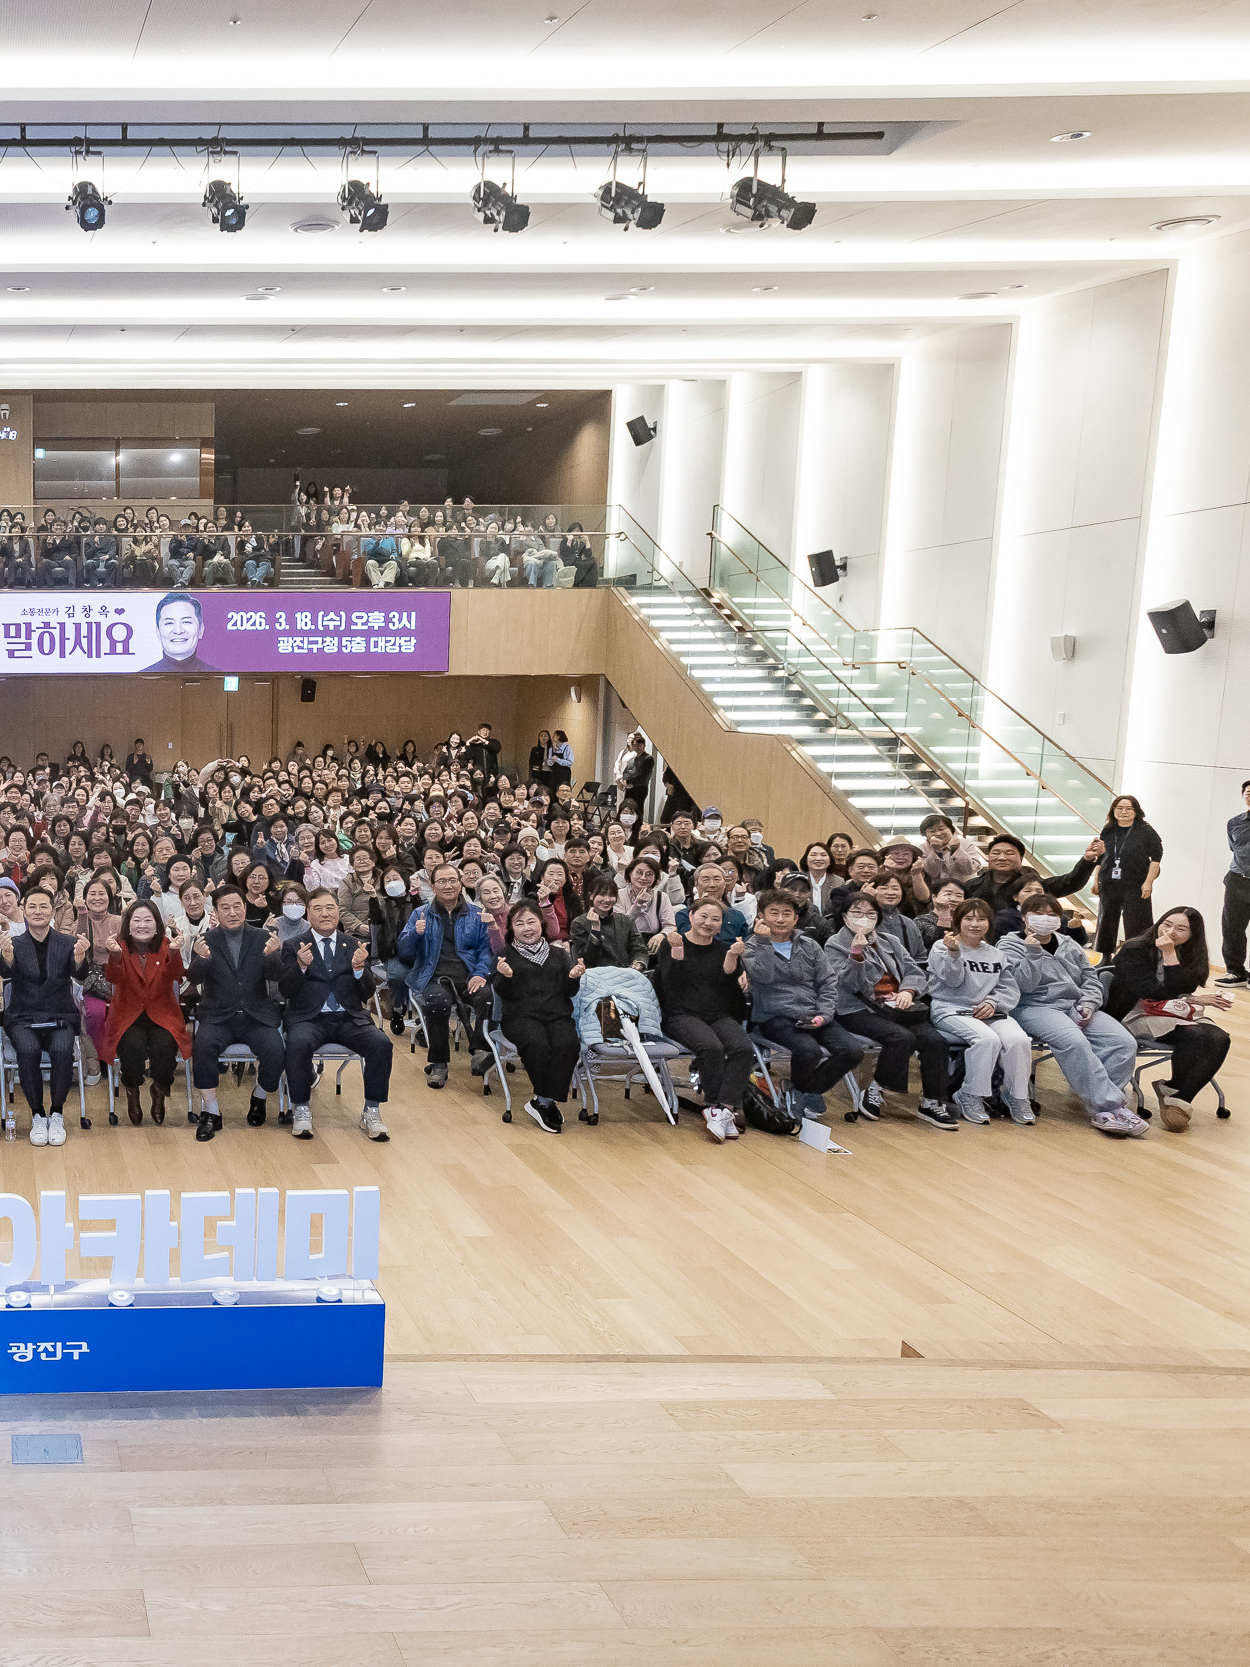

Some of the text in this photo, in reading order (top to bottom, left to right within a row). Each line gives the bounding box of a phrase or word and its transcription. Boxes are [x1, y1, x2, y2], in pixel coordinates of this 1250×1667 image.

[20, 607, 60, 617] 소통전문가
[226, 611, 270, 631] 2026.
[275, 611, 290, 631] 3.
[350, 611, 385, 631] 오후
[388, 611, 416, 631] 3시
[1, 621, 135, 659] 말하세요
[277, 636, 417, 654] 광진구청 5층 대강당
[963, 959, 1003, 974] REA
[7, 1341, 91, 1363] 광진구
